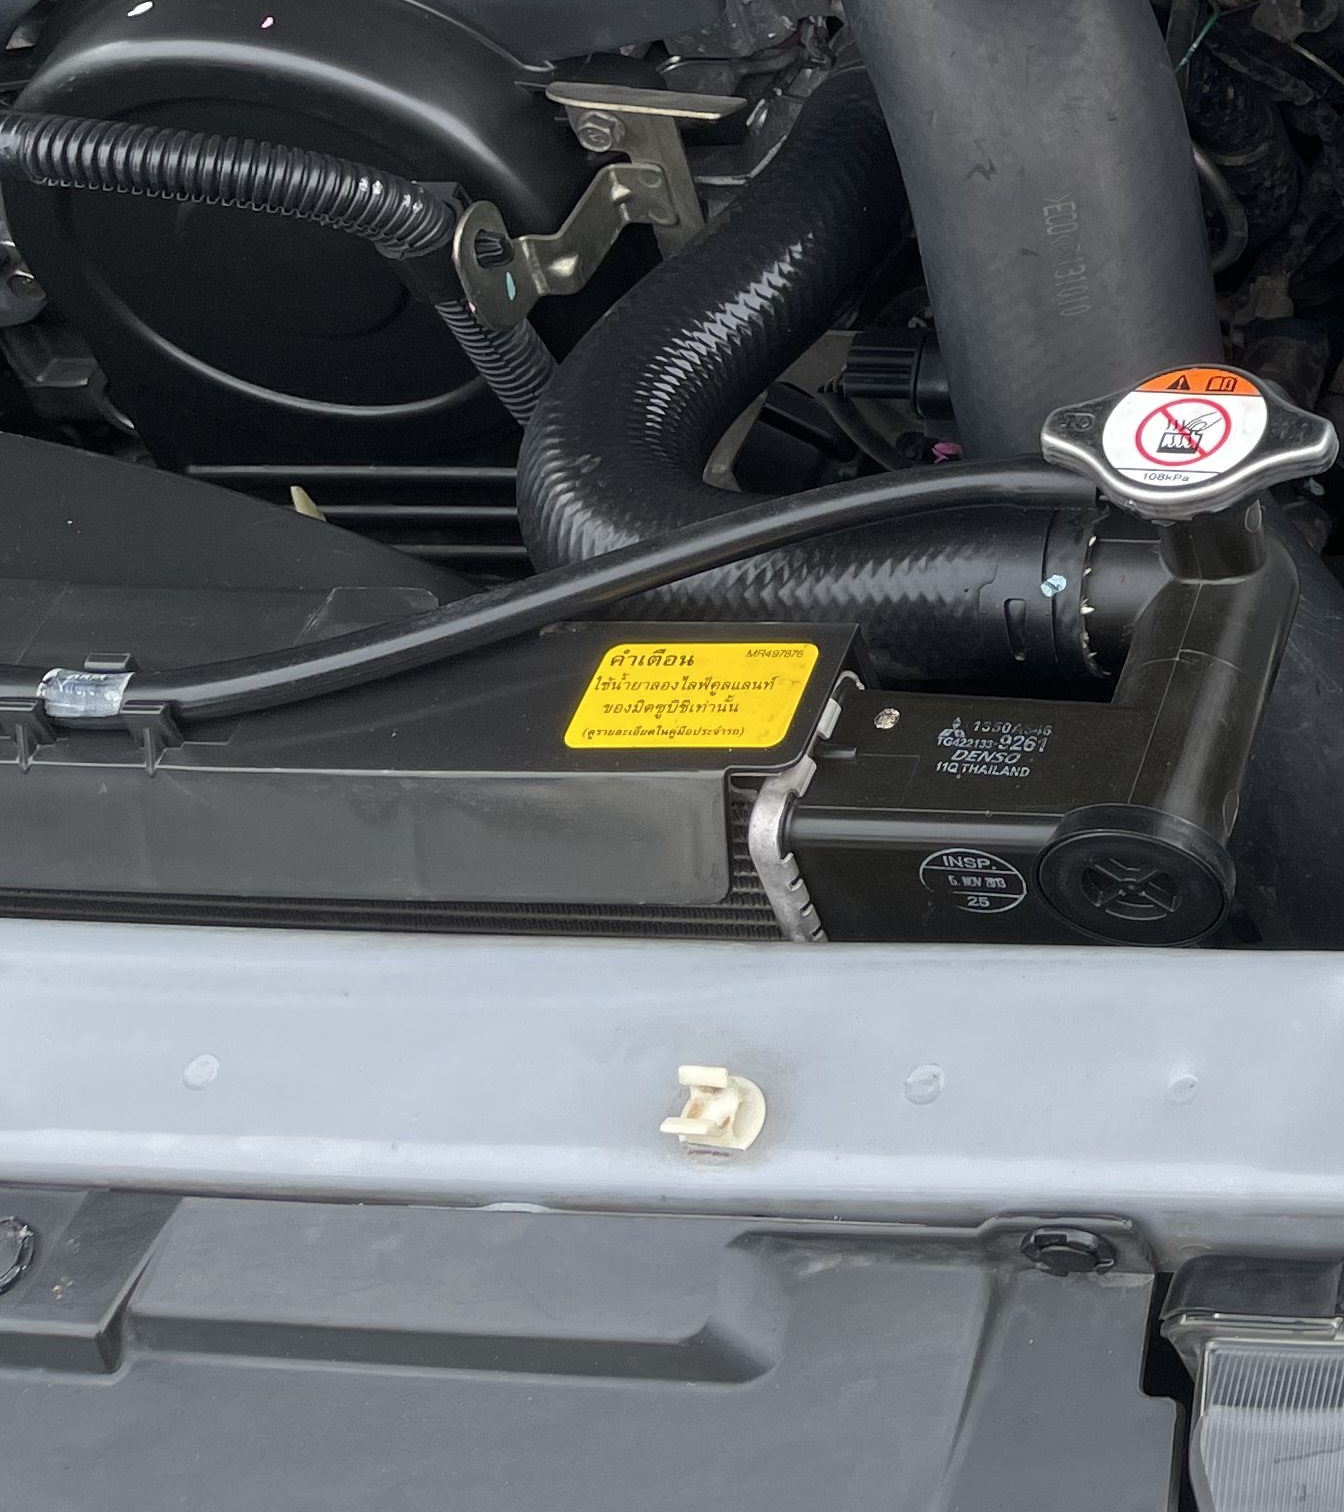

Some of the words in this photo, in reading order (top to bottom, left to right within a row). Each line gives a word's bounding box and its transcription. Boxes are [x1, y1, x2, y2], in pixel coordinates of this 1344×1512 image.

[1142, 472, 1190, 482] 108kPa
[610, 649, 695, 667] คำเตือน
[951, 749, 1021, 764] DENSO
[961, 763, 1031, 777] THAILAND
[942, 855, 997, 870] INSP.
[967, 896, 990, 907] 25
